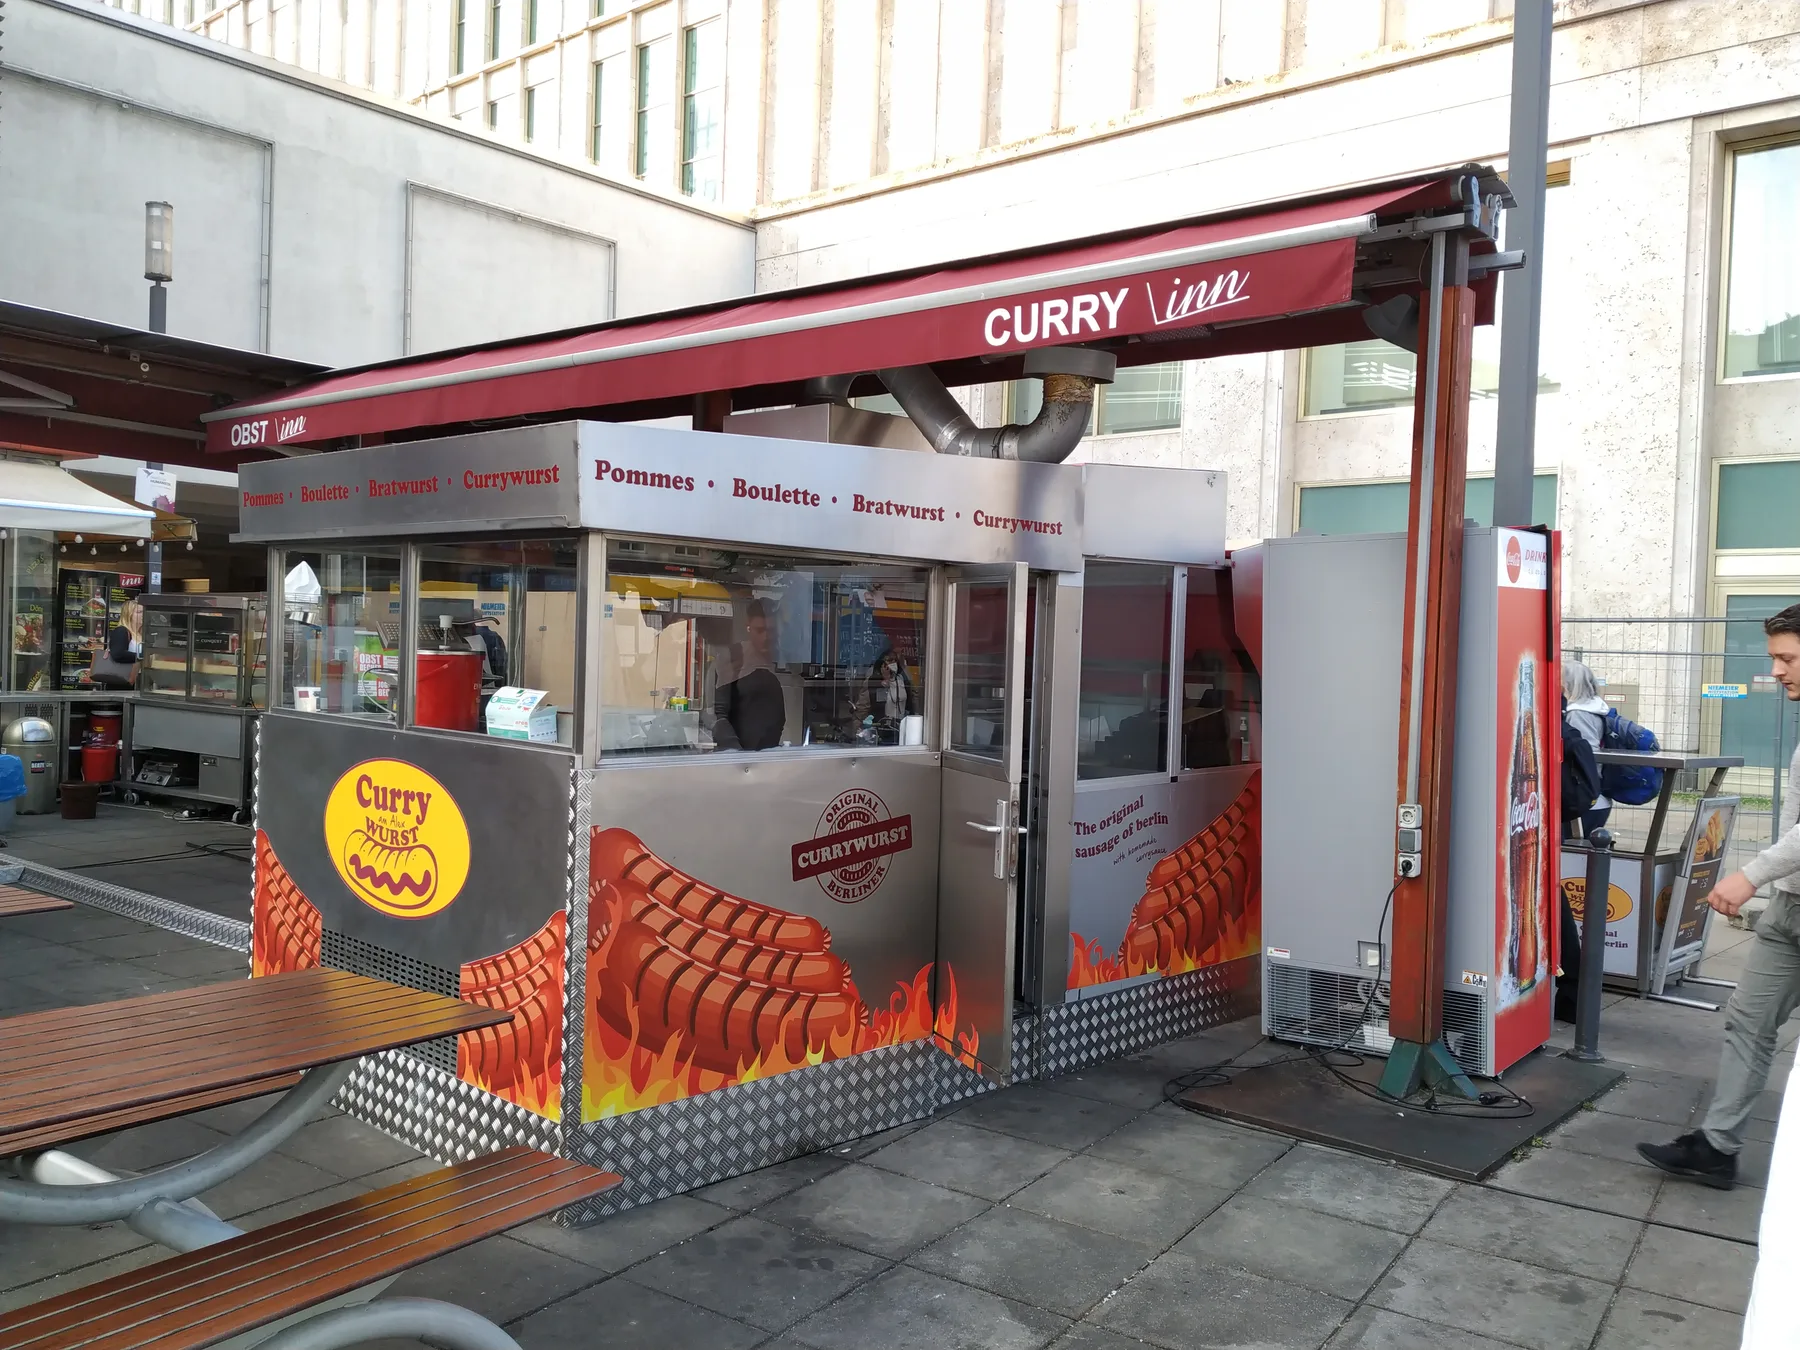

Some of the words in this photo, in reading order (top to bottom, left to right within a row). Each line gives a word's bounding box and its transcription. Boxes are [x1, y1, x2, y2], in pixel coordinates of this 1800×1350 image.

[984, 287, 1129, 347] CURRY
[1150, 270, 1250, 323] inn
[231, 420, 268, 446] OBST
[277, 415, 306, 441] inn
[243, 491, 284, 507] Pommes
[301, 484, 349, 503] Boulette
[369, 475, 438, 498] Bratwurst
[463, 464, 560, 491] Currywurst
[594, 459, 695, 491] Pommes
[732, 477, 821, 507] Boulette
[852, 493, 945, 522] Bratwurst
[973, 509, 1063, 536] Currywurst
[121, 576, 143, 586] inn
[360, 653, 380, 664] OBST
[356, 774, 432, 825] Curry
[825, 793, 880, 824] ORIGINAL
[1074, 822, 1097, 836] The
[1100, 795, 1144, 830] original
[365, 816, 419, 846] WURST
[378, 816, 388, 826] am
[390, 814, 406, 828] Alex
[1075, 834, 1119, 858] sausage
[1122, 823, 1134, 840] of
[1136, 811, 1169, 831] berlin
[797, 825, 908, 868] CURRYWURST
[1113, 850, 1126, 865] with
[1128, 834, 1158, 857] homemade
[826, 865, 886, 899] BERLINER
[1604, 940, 1628, 948] erlin
